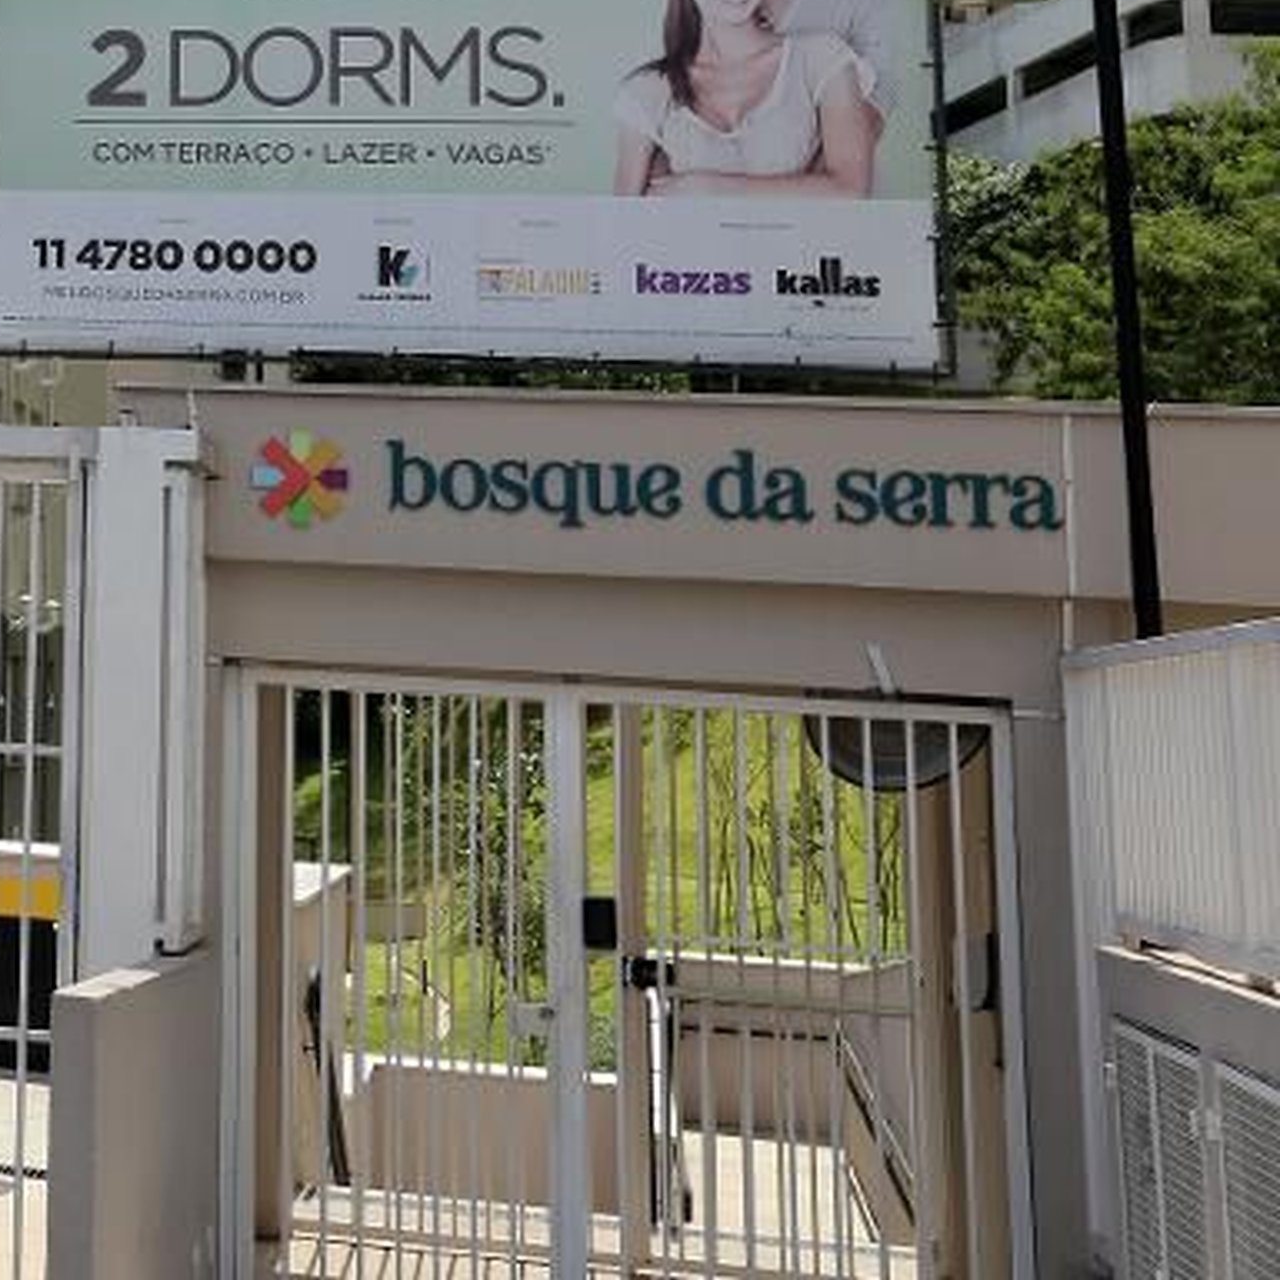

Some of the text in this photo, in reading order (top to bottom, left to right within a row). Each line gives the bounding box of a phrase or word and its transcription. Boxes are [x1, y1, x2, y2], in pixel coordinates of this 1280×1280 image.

[86, 26, 565, 107] 2 DORMS.
[92, 141, 155, 165] COM
[160, 141, 295, 167] TERRAÇO
[324, 141, 418, 165] LAZER
[32, 238, 318, 274] 11 4780 0000
[775, 256, 881, 297] kallas
[386, 439, 1067, 532] bosque da serra
